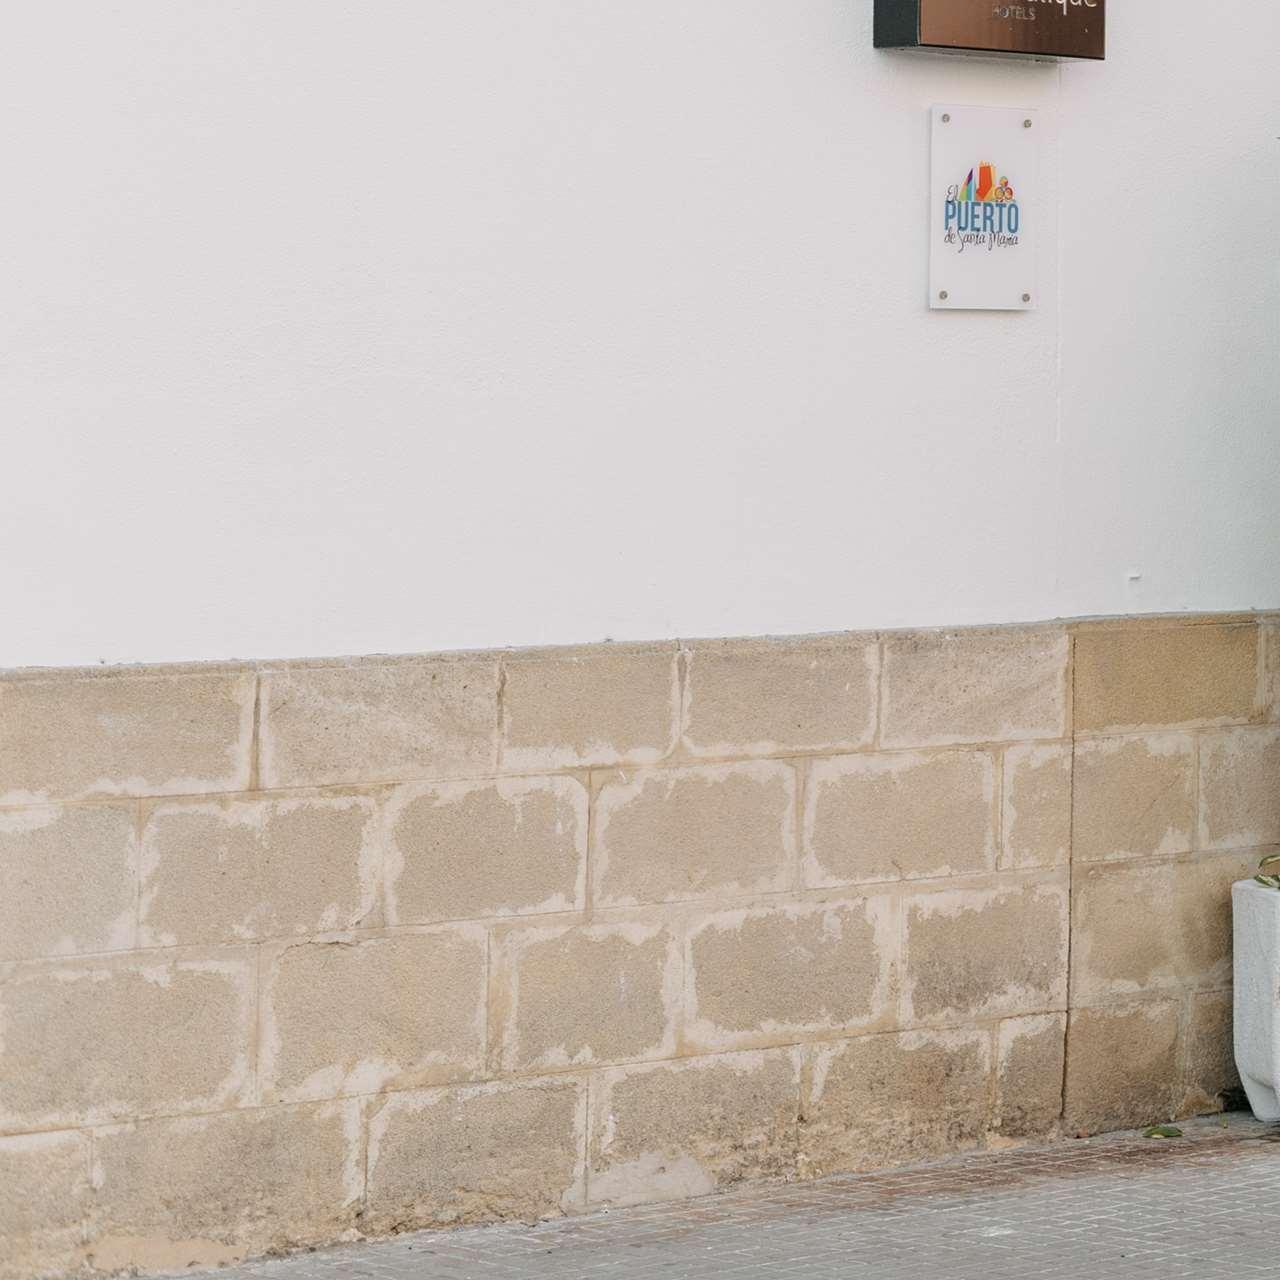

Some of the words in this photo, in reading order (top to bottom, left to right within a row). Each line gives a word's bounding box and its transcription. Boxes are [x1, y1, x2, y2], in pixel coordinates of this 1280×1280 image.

[992, 5, 1037, 20] HOTELS
[943, 199, 1020, 234] PUERTO
[943, 226, 955, 245] de
[956, 228, 986, 253] Santa
